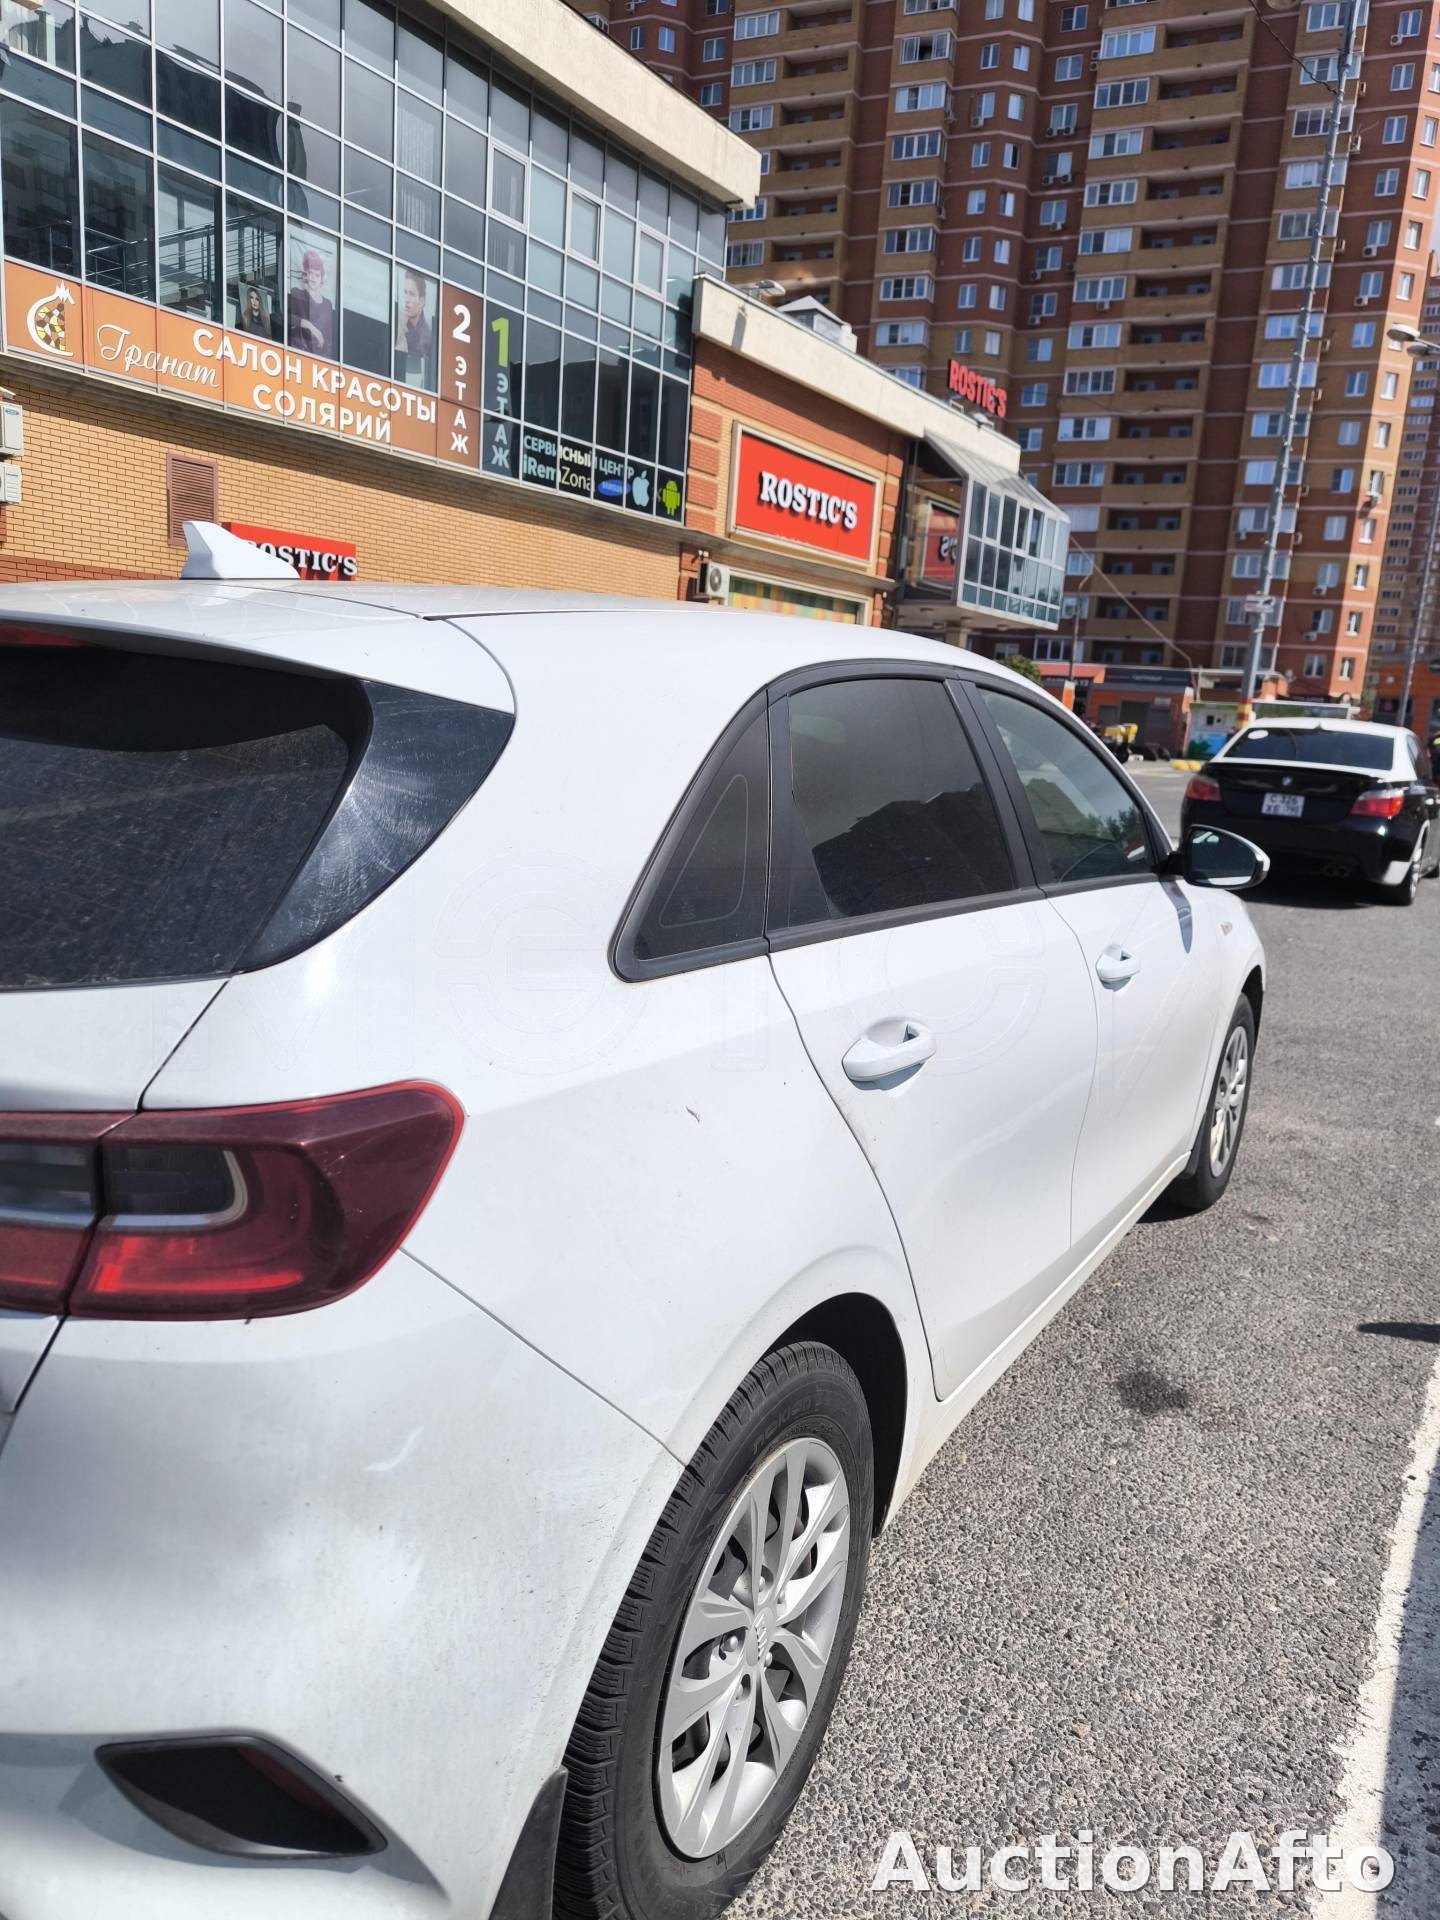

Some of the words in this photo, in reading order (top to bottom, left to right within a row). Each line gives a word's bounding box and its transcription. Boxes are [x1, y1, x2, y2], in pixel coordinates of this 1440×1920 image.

[452, 304, 471, 343] 2
[491, 317, 509, 367] 1
[96, 324, 220, 388] Гранат
[193, 329, 302, 384] САЛОН
[312, 363, 436, 424] КРАСОТЫ
[252, 384, 391, 442] СОЛЯРИЙ
[949, 359, 1007, 417] ROSTIC'S
[524, 435, 597, 469] СЕРВИСНЫЙ
[759, 471, 858, 529] ROSTIC'S
[248, 541, 358, 576] OSTIC'S
